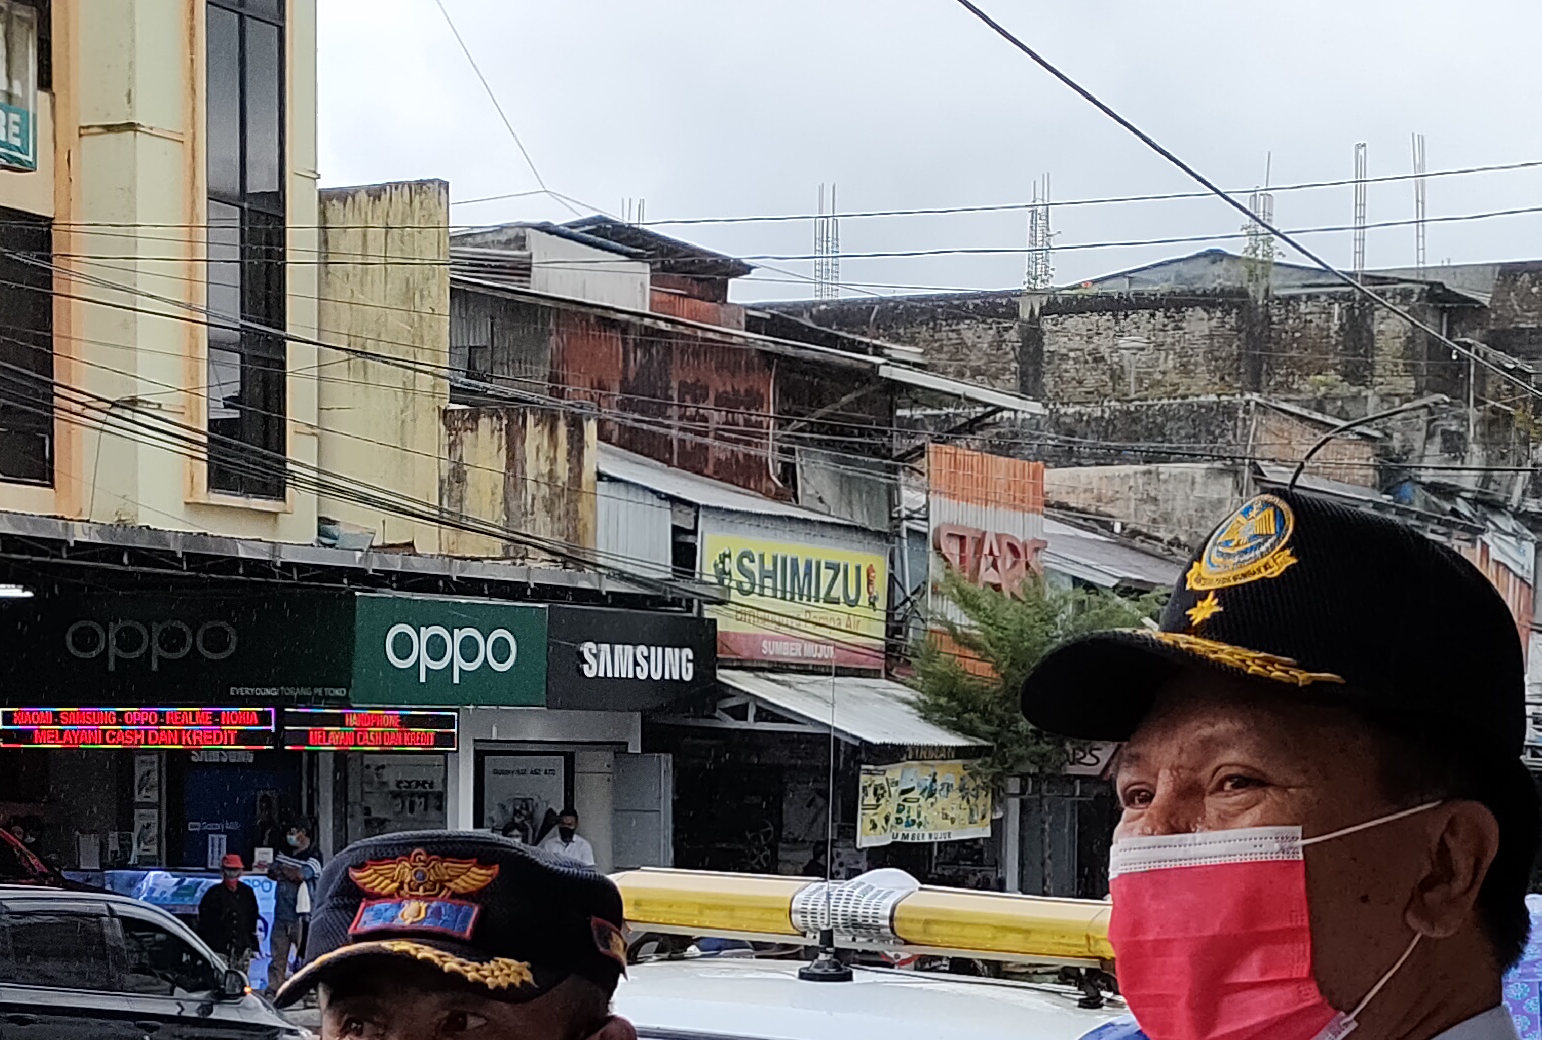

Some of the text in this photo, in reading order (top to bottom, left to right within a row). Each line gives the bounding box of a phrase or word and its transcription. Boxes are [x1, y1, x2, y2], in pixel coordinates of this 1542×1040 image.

[735, 549, 862, 608] SHIMIZU
[65, 619, 238, 673] oppo
[385, 622, 518, 684] oppo
[761, 639, 802, 656] SUMBER
[580, 641, 694, 683] SAMSUNG
[60, 711, 117, 725] SAMSUNG
[124, 712, 158, 725] OPPO
[165, 712, 213, 725] REALME
[220, 712, 259, 725] NOKIA
[33, 730, 238, 745] MELAYANI CASH DAN KREDIT
[309, 731, 436, 746] MELAYANI CASH DAN KREDIT
